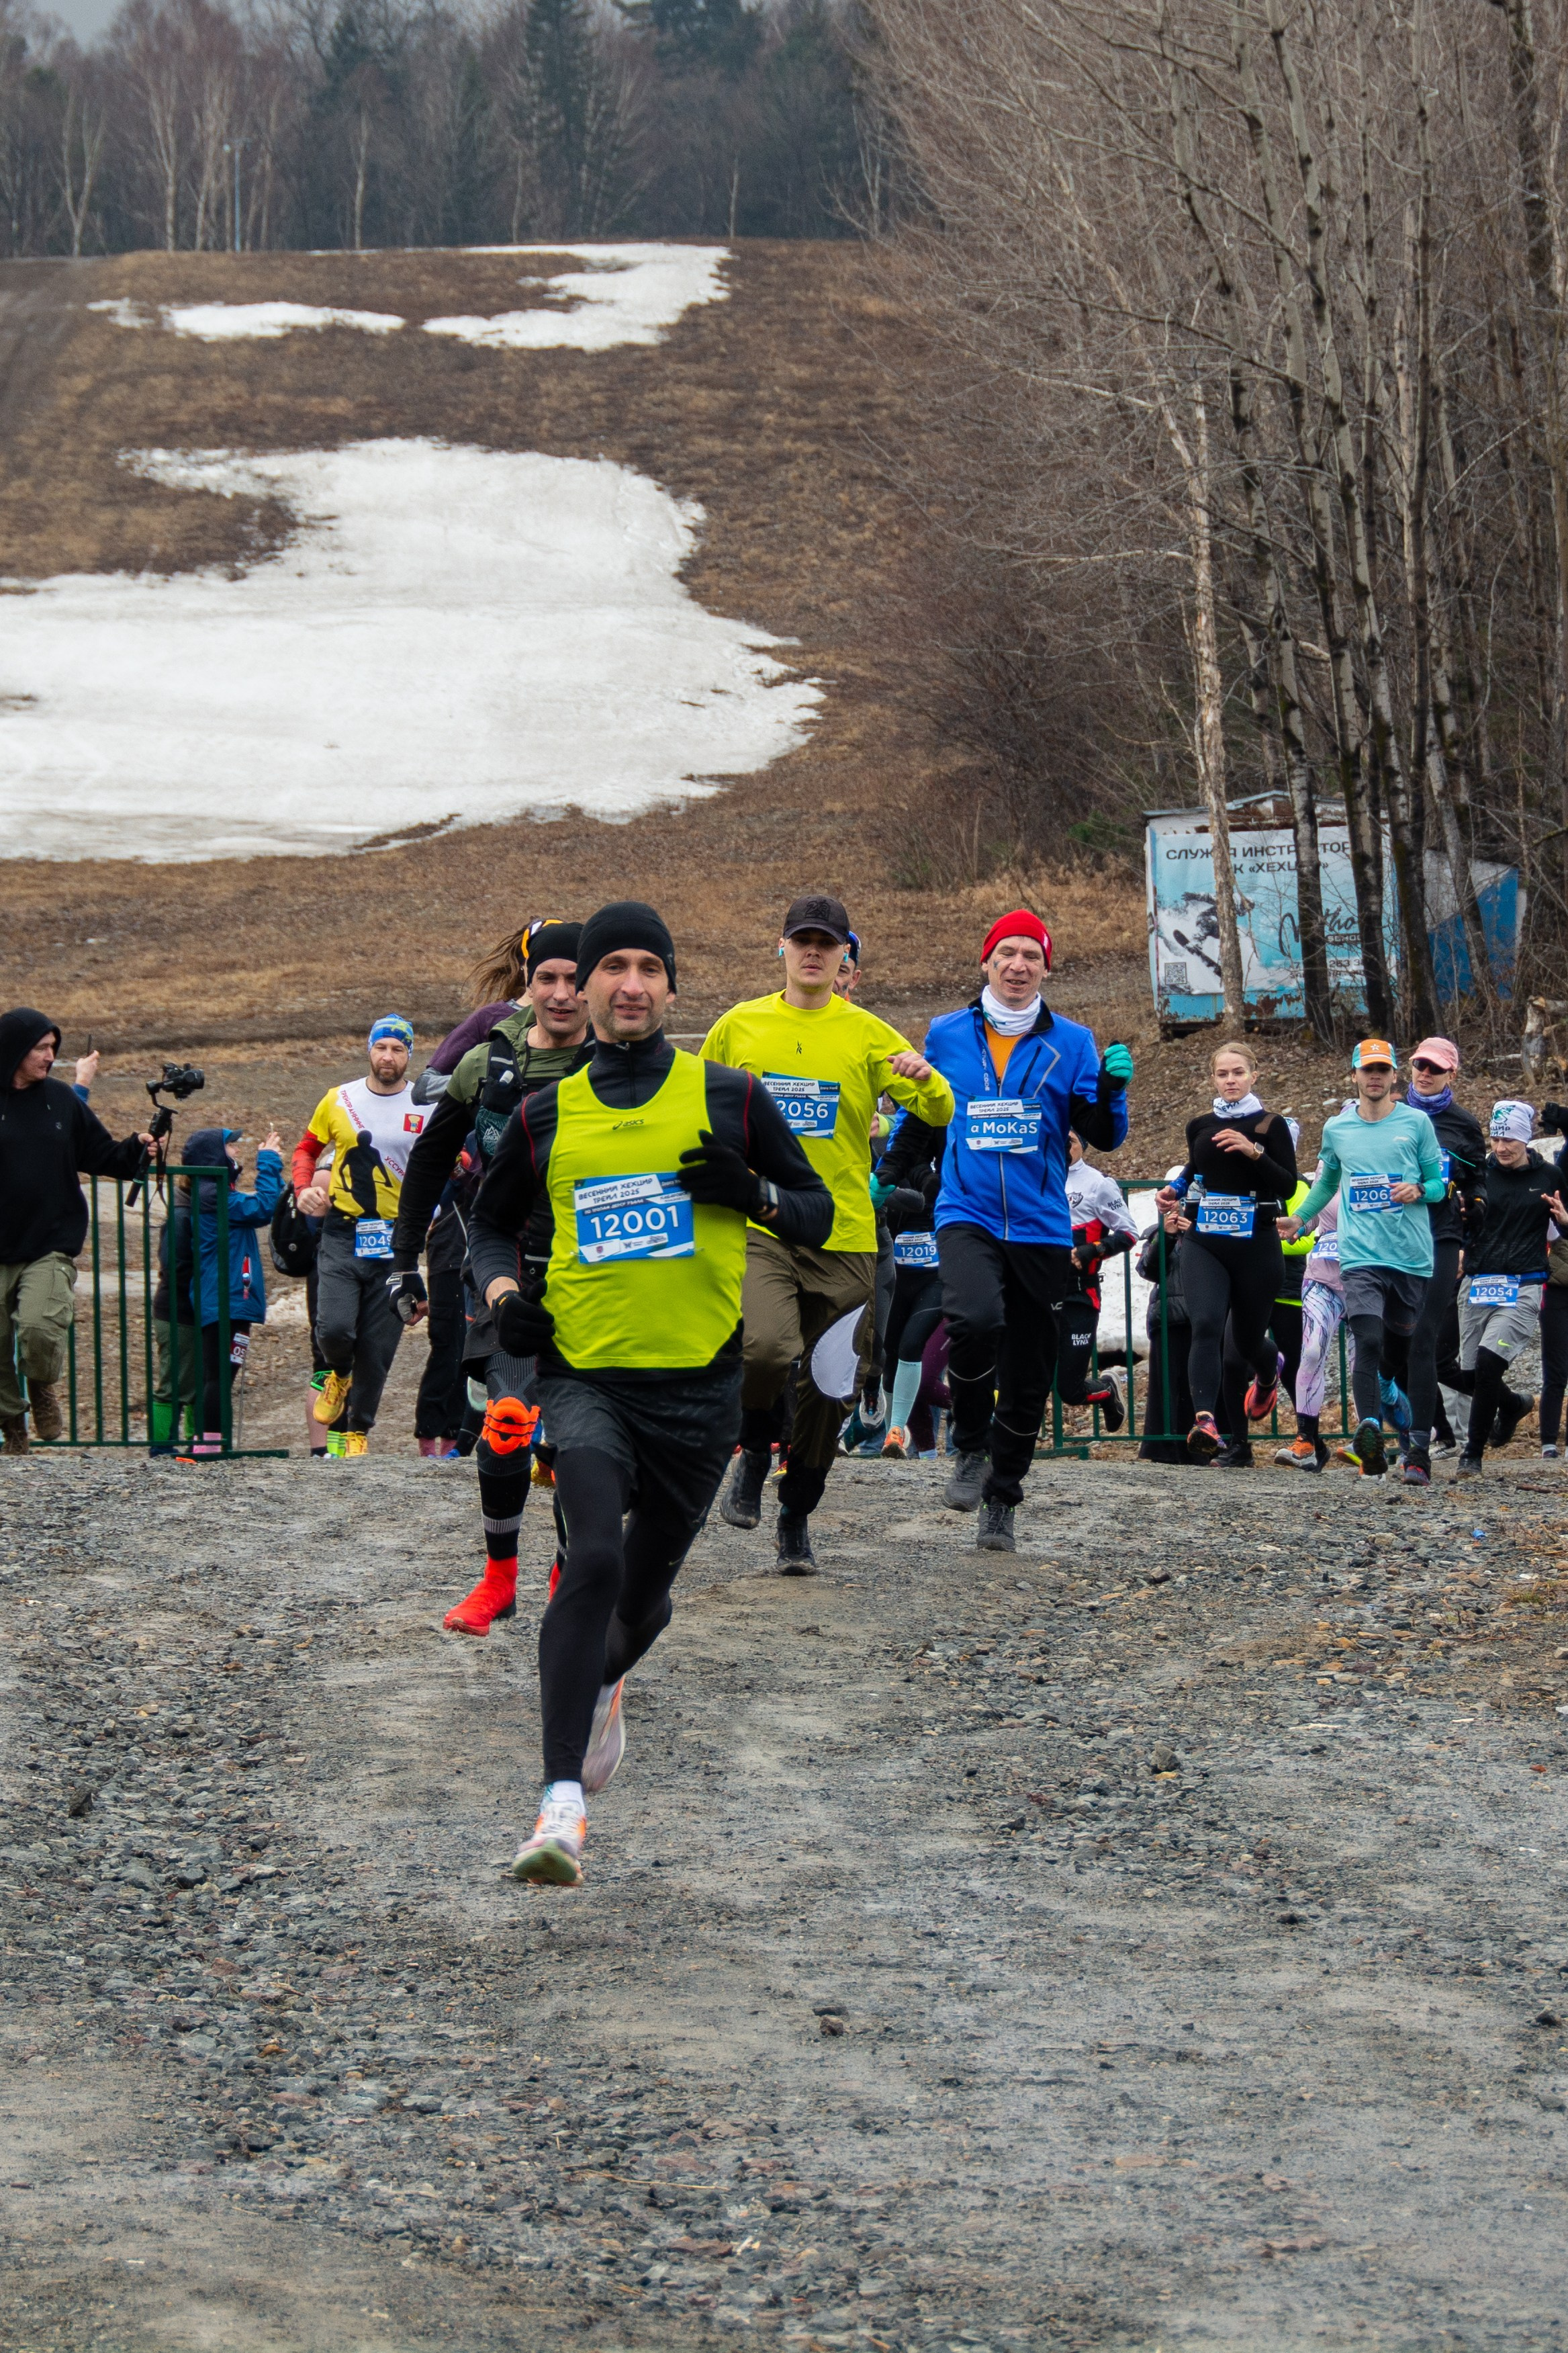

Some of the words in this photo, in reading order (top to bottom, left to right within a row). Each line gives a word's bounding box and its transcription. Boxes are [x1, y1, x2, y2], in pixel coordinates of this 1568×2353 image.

[1166, 846, 1237, 860] СЛУЖА
[1242, 840, 1350, 858] ИНСТРТОР
[1248, 861, 1329, 874] «ХЕХЦ»
[776, 1100, 829, 1118] 2056
[982, 1122, 1037, 1134] MoKaS
[620, 1188, 639, 1198] 2025
[590, 1205, 679, 1239] 12001
[1204, 1211, 1248, 1223] 12063
[901, 1246, 937, 1257] 12019
[1319, 1243, 1338, 1251] 120
[1475, 1287, 1512, 1297] 12054
